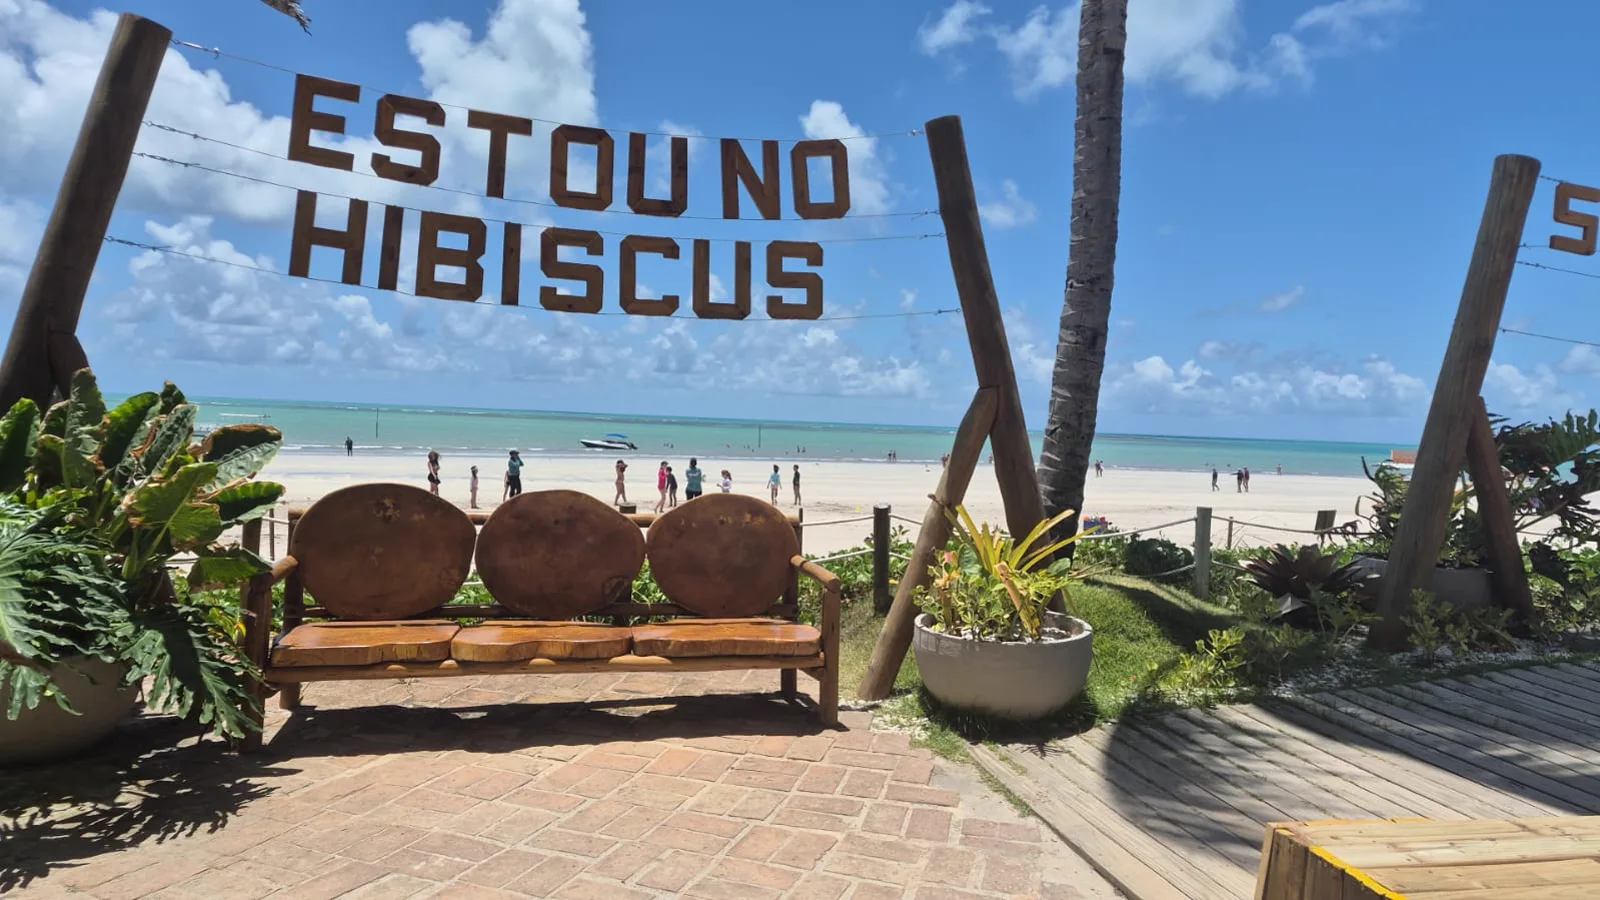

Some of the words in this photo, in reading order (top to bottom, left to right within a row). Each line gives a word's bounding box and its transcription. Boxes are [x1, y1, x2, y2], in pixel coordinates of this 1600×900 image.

[289, 73, 688, 216] ESTOU
[721, 139, 851, 220] NO
[289, 190, 824, 320] HIBISCUS
